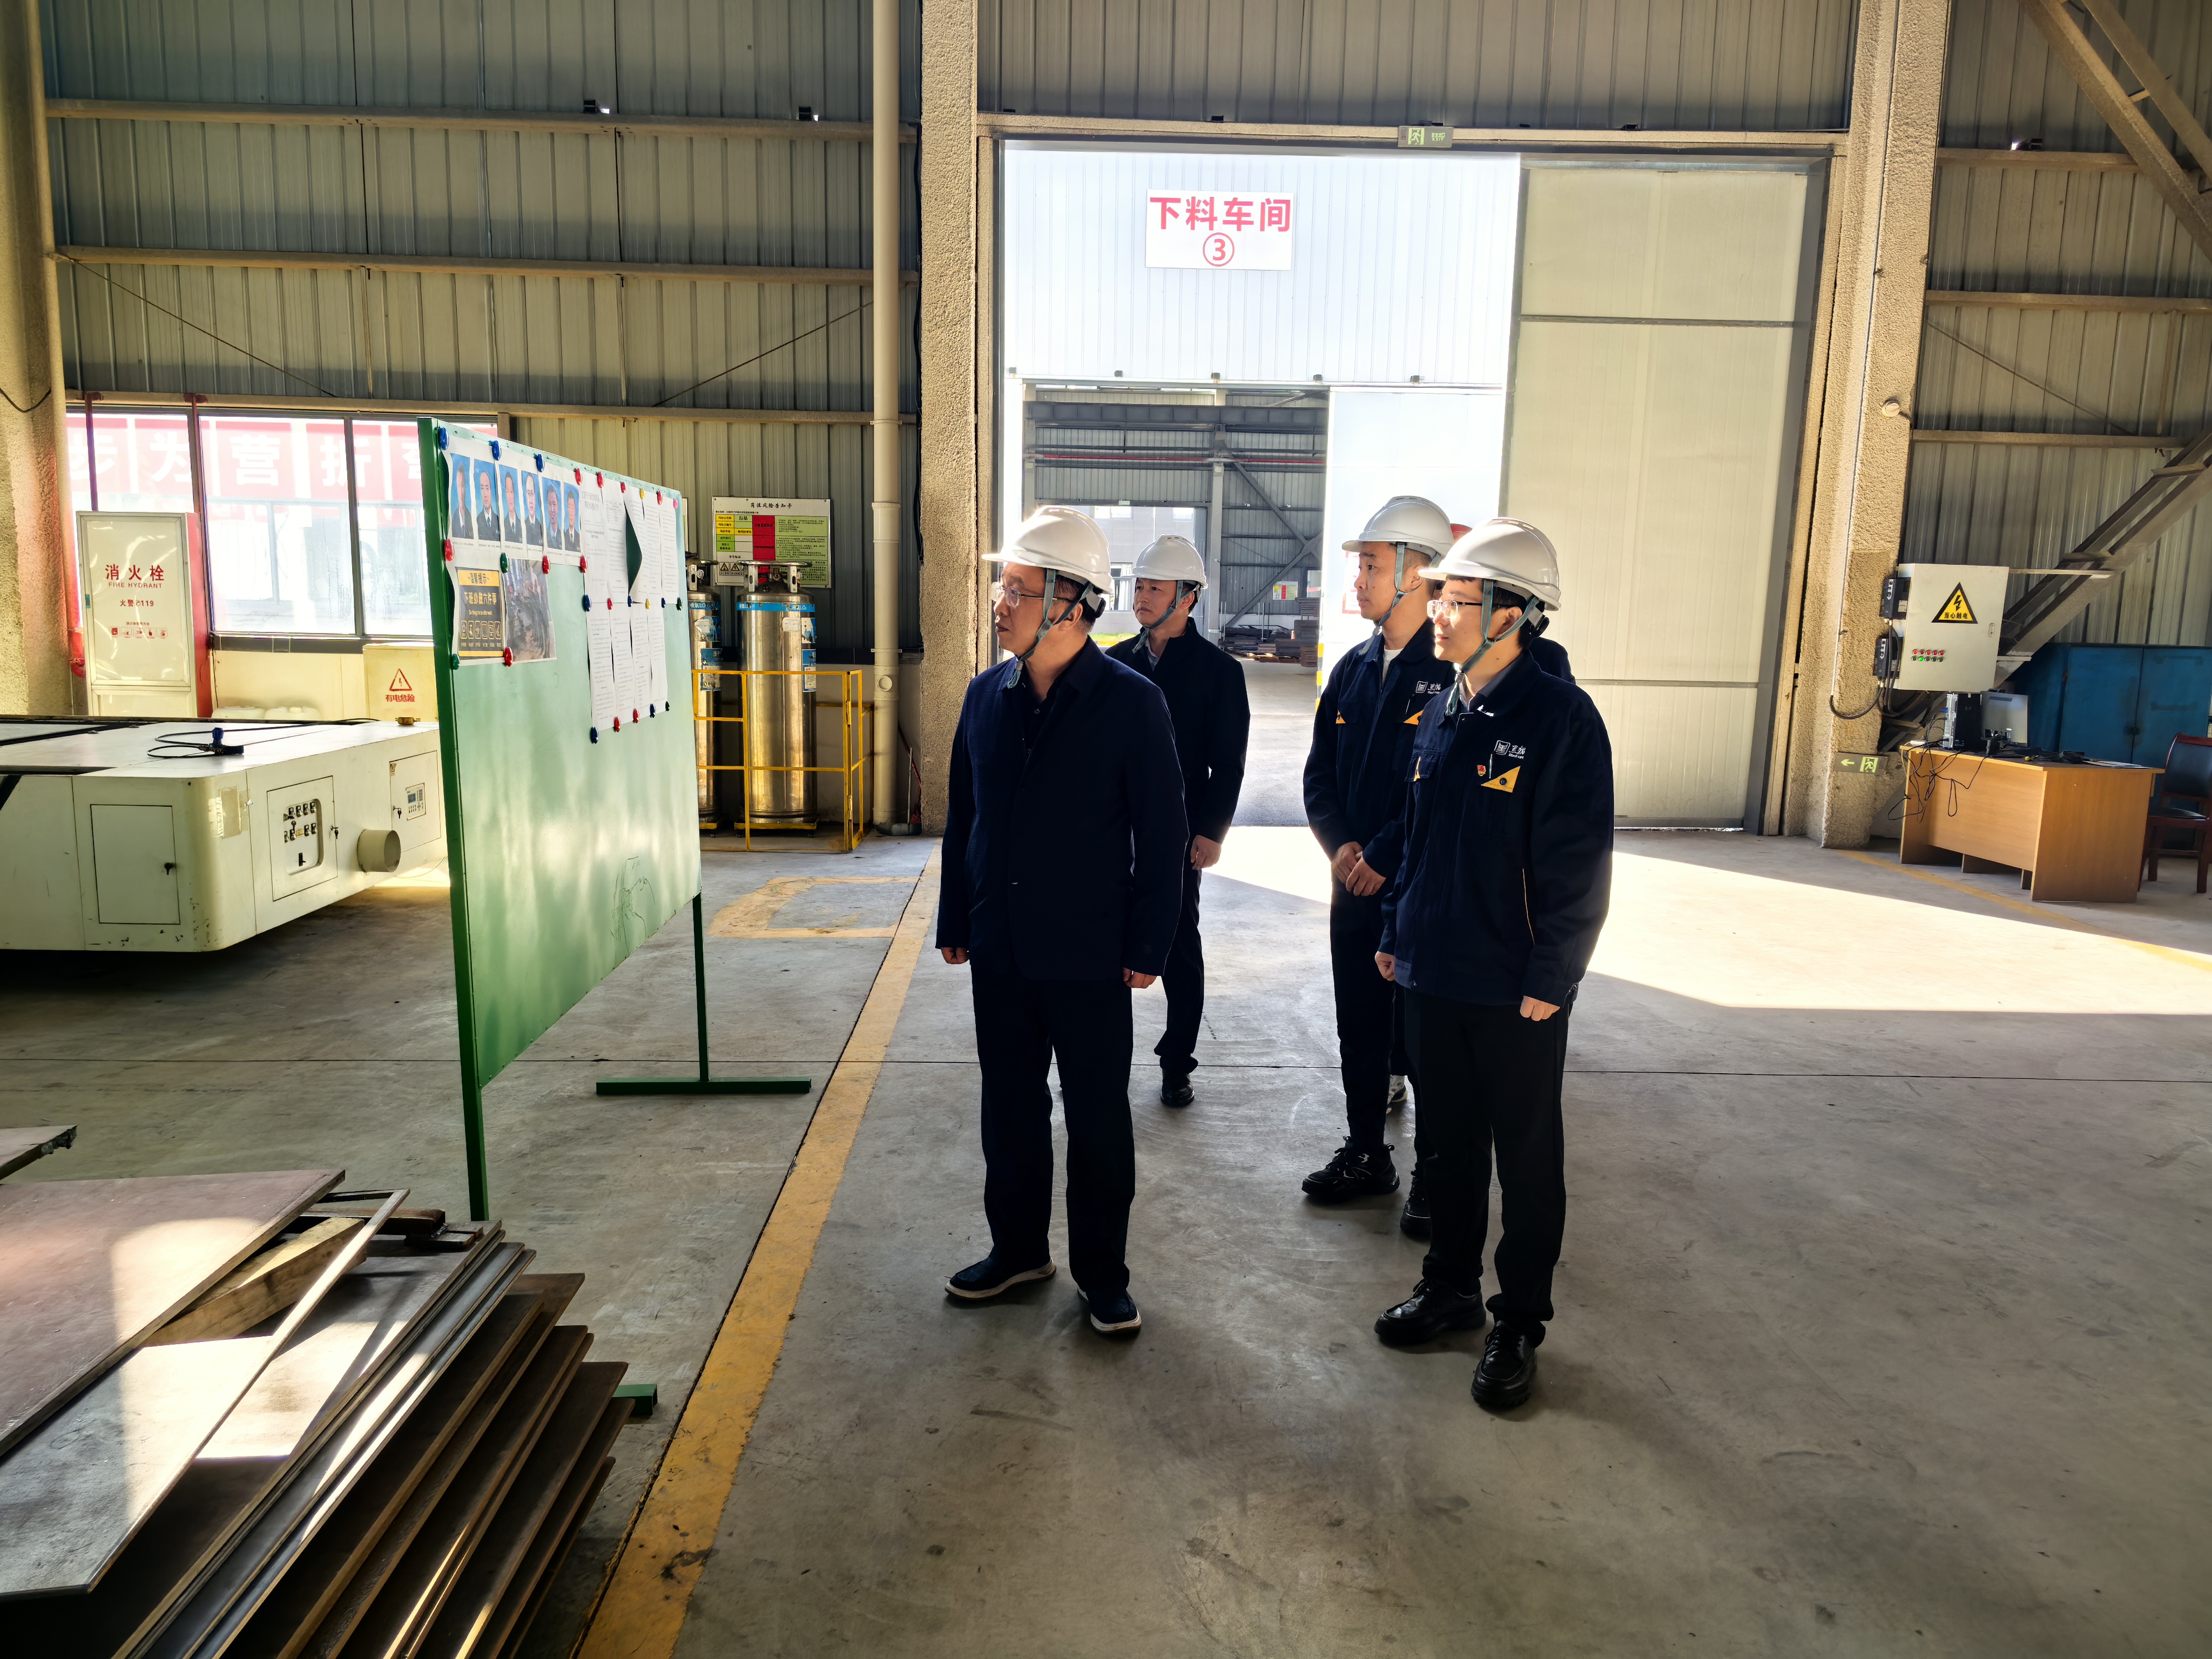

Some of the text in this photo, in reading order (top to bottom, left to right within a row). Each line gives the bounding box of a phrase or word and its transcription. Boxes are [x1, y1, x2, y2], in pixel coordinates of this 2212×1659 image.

[1149, 196, 1291, 232] 下料车间
[105, 564, 164, 581] 消火栓
[385, 694, 415, 702] 有电危险
